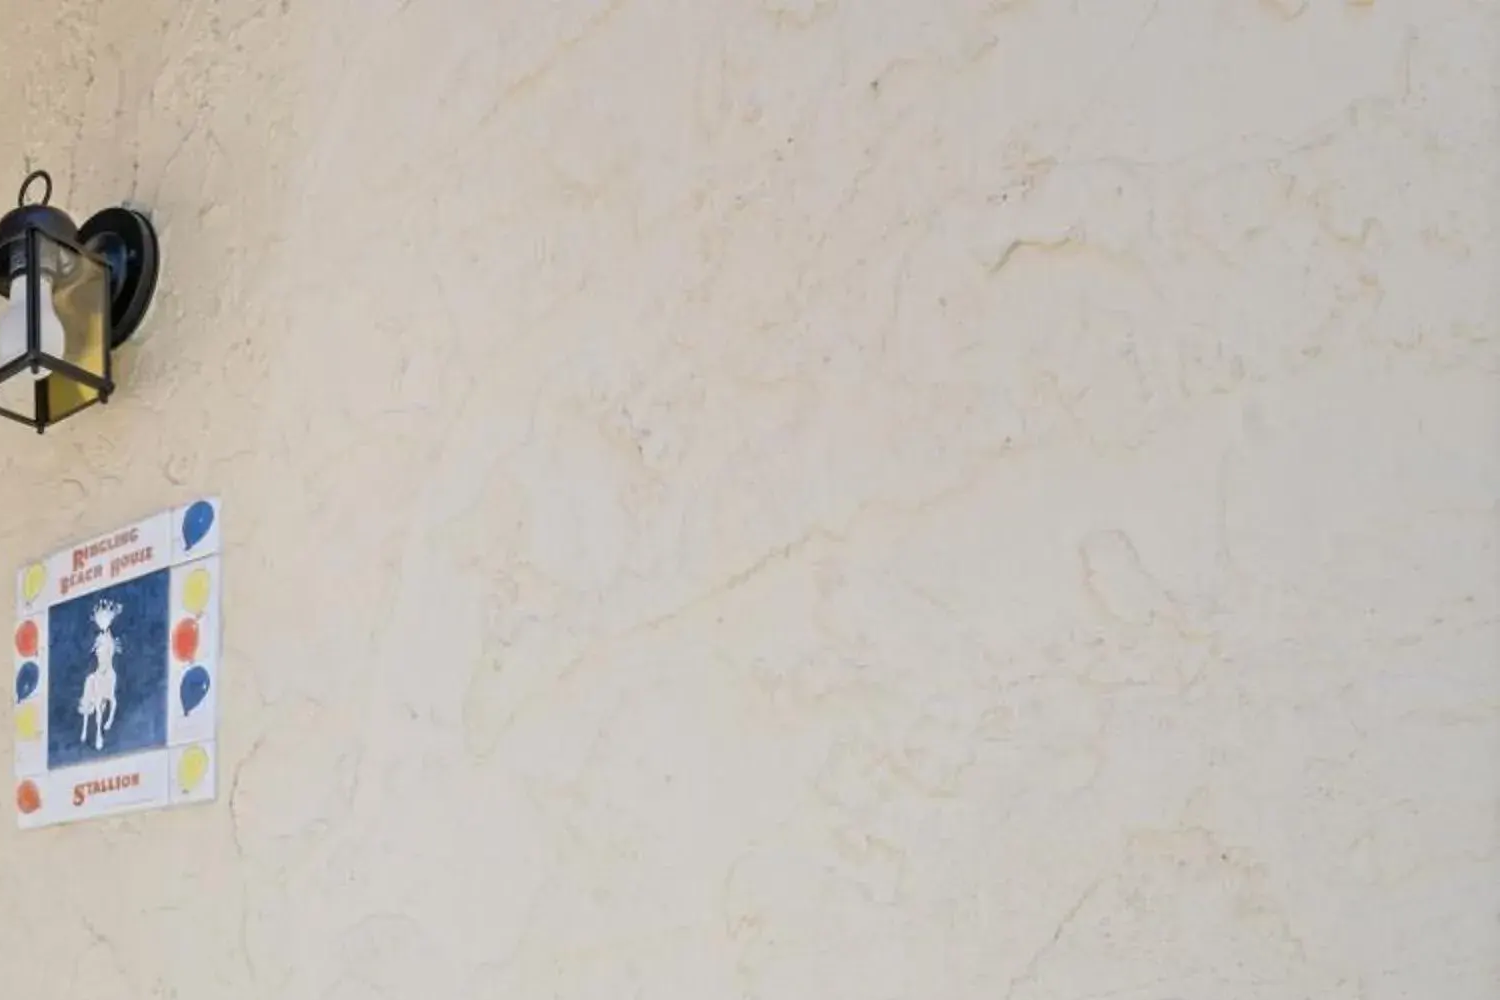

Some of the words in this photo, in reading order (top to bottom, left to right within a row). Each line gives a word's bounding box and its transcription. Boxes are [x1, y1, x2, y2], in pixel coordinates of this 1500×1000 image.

[59, 563, 104, 595] BEACH
[109, 546, 154, 578] HOUSE
[72, 527, 140, 572] RINGLING
[72, 773, 140, 807] STALLION
